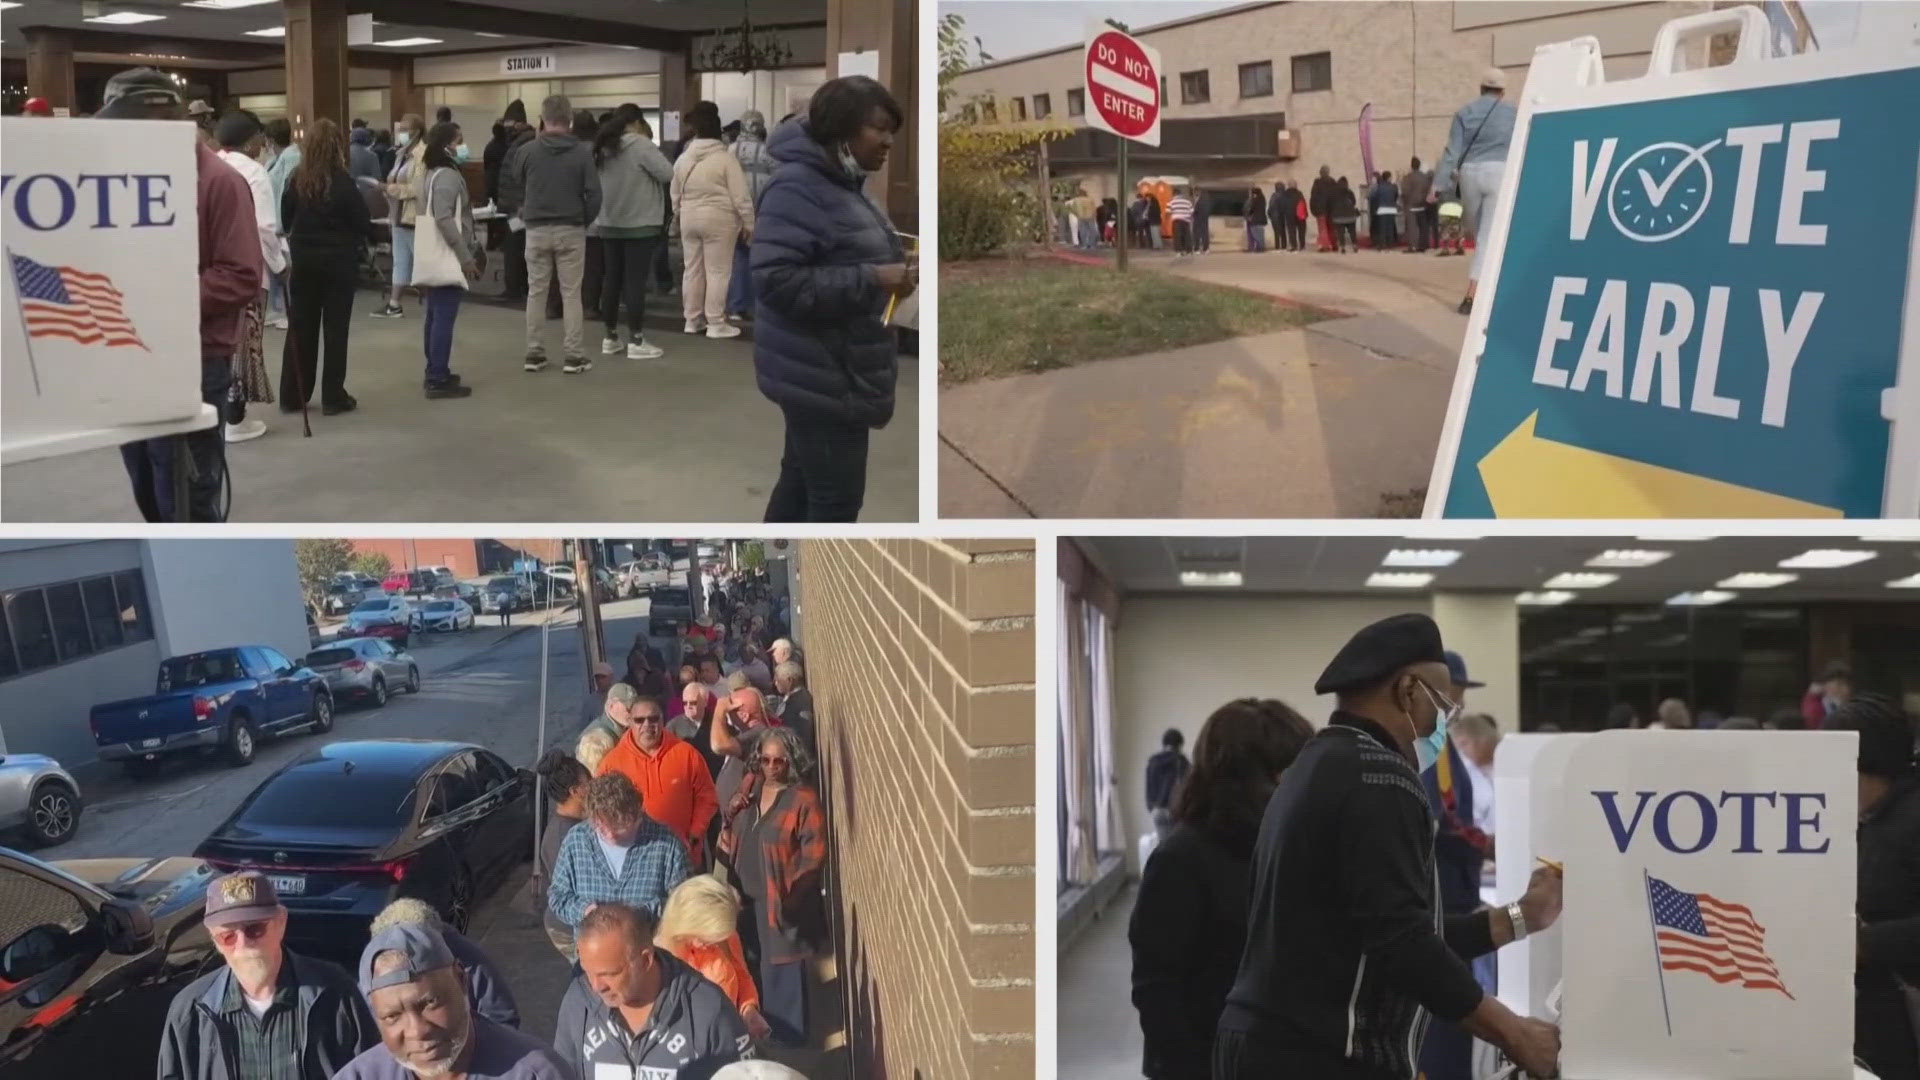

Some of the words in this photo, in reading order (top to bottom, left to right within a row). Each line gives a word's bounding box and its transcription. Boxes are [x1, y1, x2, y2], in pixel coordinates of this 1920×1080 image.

[507, 57, 542, 70] STATION
[1098, 42, 1117, 65] DO
[1125, 56, 1150, 80] NOT
[1104, 92, 1145, 122] ENTER
[1, 174, 176, 231] OTE
[1570, 118, 1841, 246] VOTE
[1532, 276, 1825, 428] EARLY
[1590, 790, 1831, 854] VOTE
